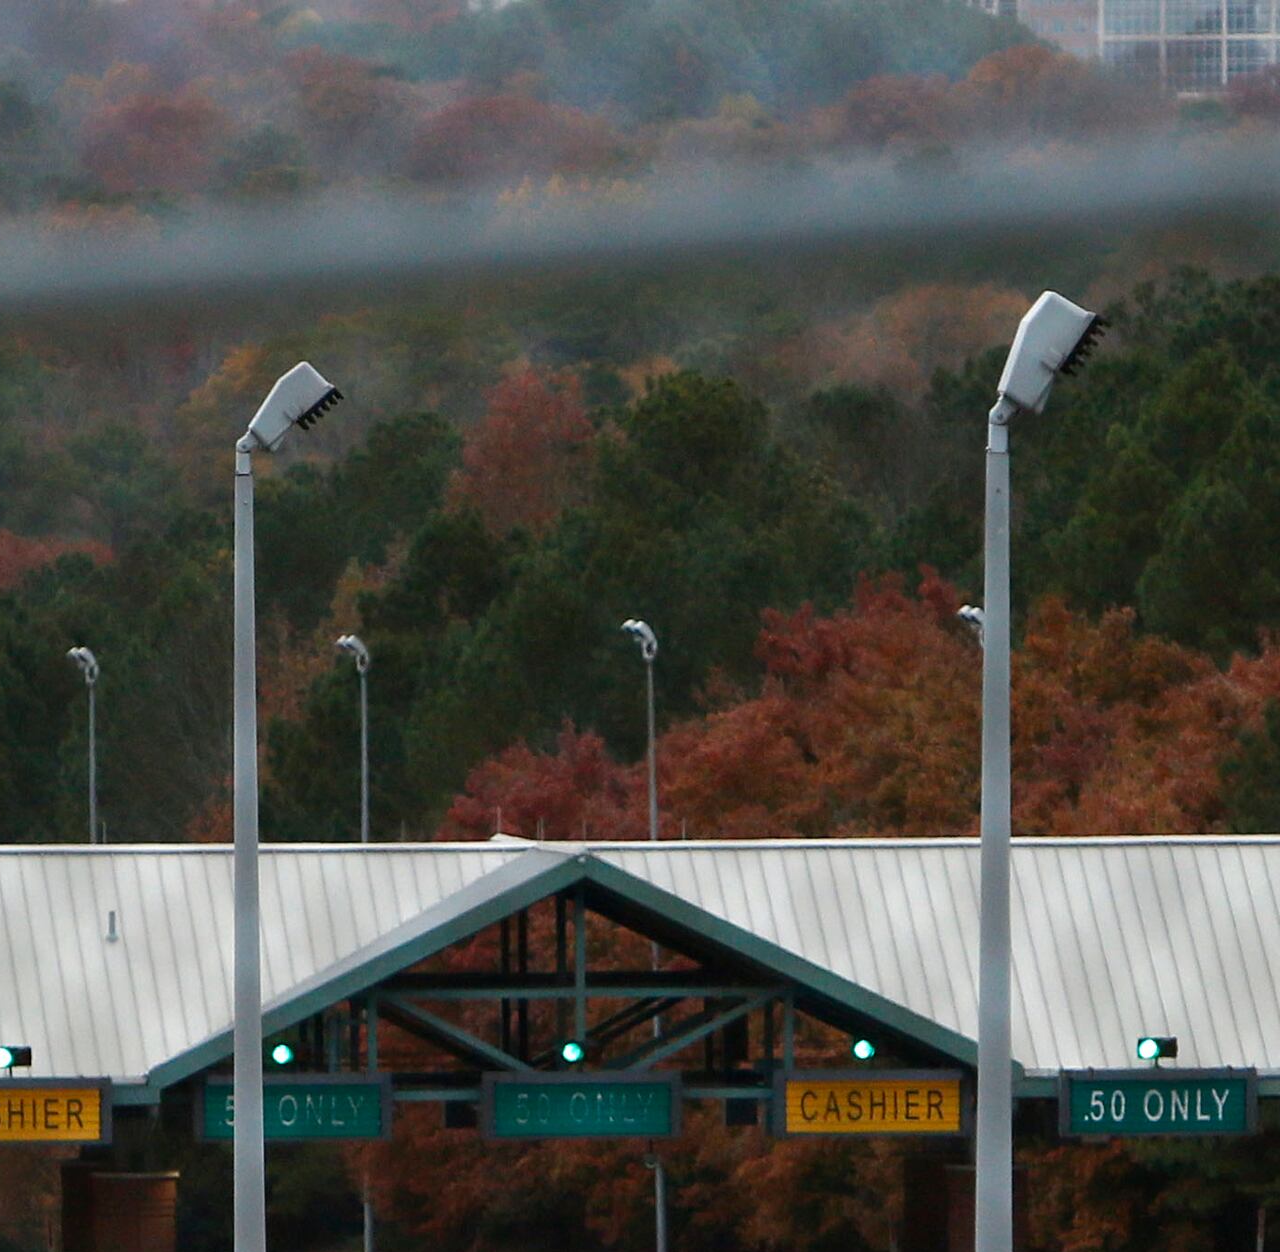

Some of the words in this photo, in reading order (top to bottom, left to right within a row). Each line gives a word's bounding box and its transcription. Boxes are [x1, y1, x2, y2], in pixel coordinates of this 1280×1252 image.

[278, 1094, 364, 1126] ONLY
[800, 1089, 945, 1122] CASHIER
[1083, 1090, 1126, 1122] .50
[1143, 1088, 1230, 1122] ONLY
